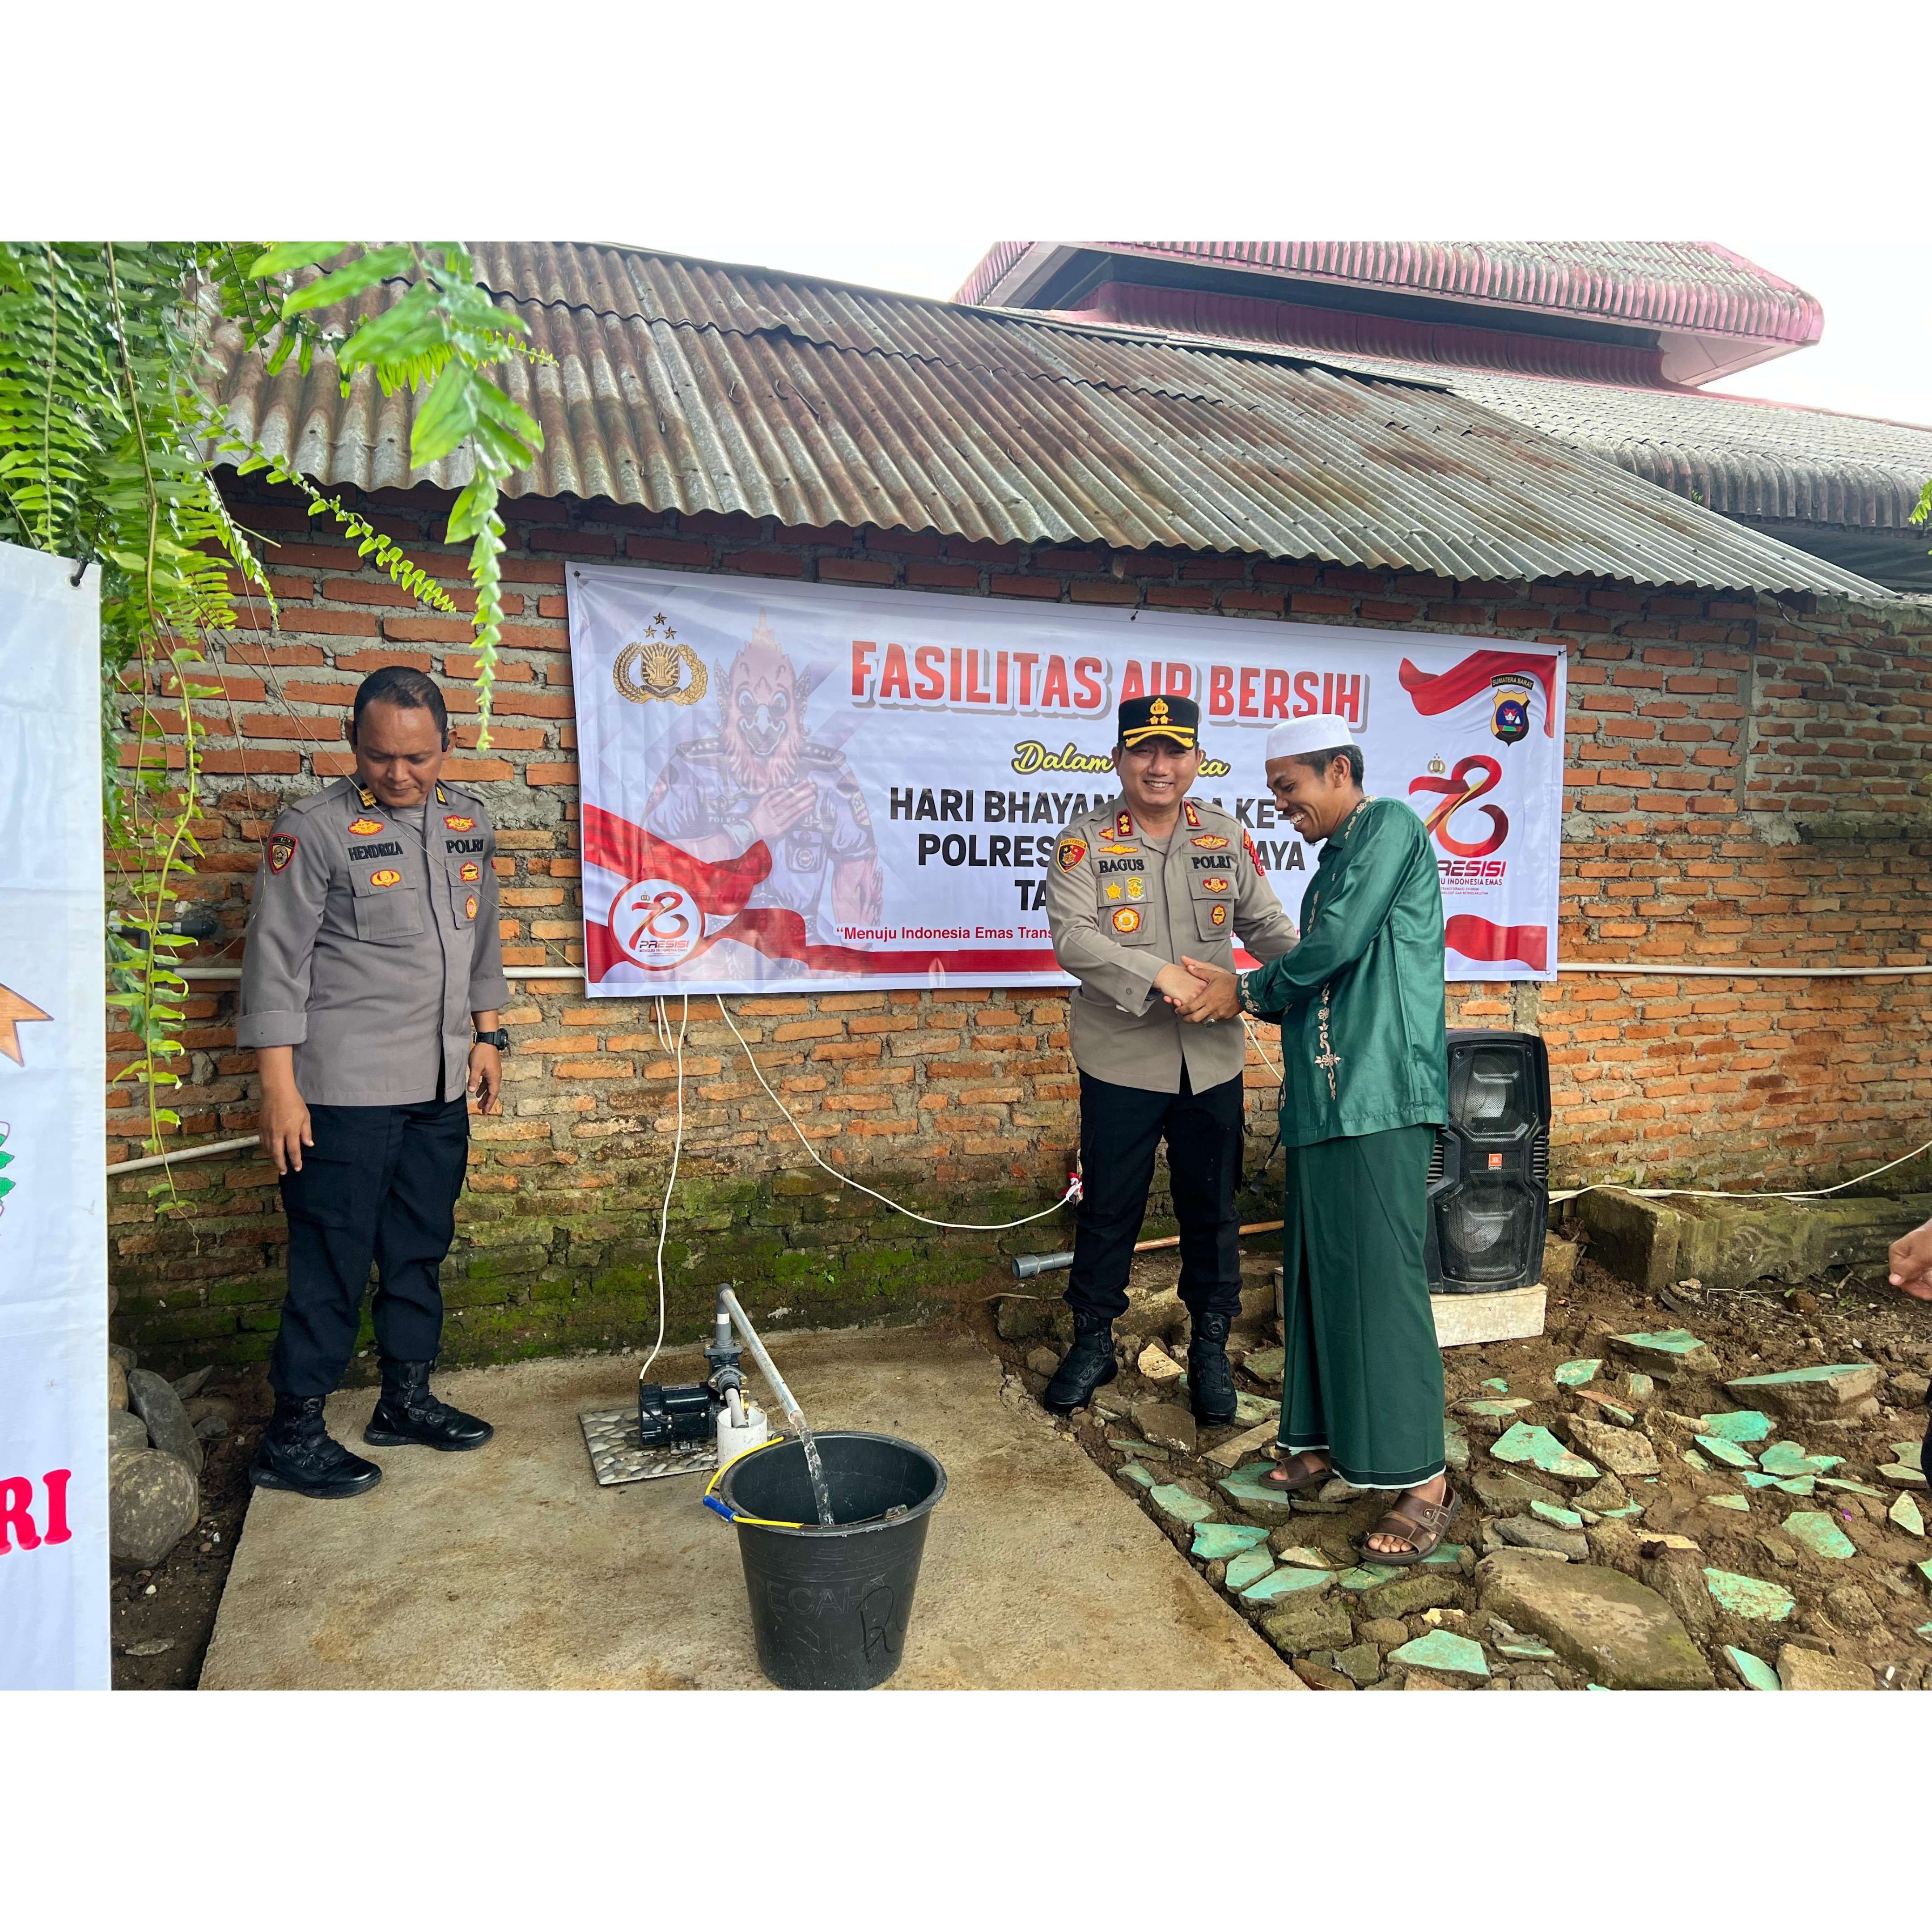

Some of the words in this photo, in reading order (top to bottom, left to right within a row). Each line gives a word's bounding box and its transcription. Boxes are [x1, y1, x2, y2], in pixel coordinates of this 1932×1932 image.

[852, 640, 1102, 708] FASILITAS
[1209, 665, 1360, 722] BERSIH
[1492, 677, 1517, 686] SUMATERA
[1517, 678, 1533, 688] BARAT
[1012, 741, 1114, 774] Dalam
[890, 787, 974, 822] HARI
[348, 841, 403, 861] HENDRIZA
[445, 839, 484, 854] POLRI
[919, 834, 1056, 867] POLRES
[1098, 859, 1145, 873] BAGUS
[1191, 855, 1232, 869] POLRI
[1437, 860, 1507, 877] RESISI
[902, 927, 970, 939] Indonesia
[975, 927, 1013, 938] Emas
[640, 940, 689, 948] PRESISI
